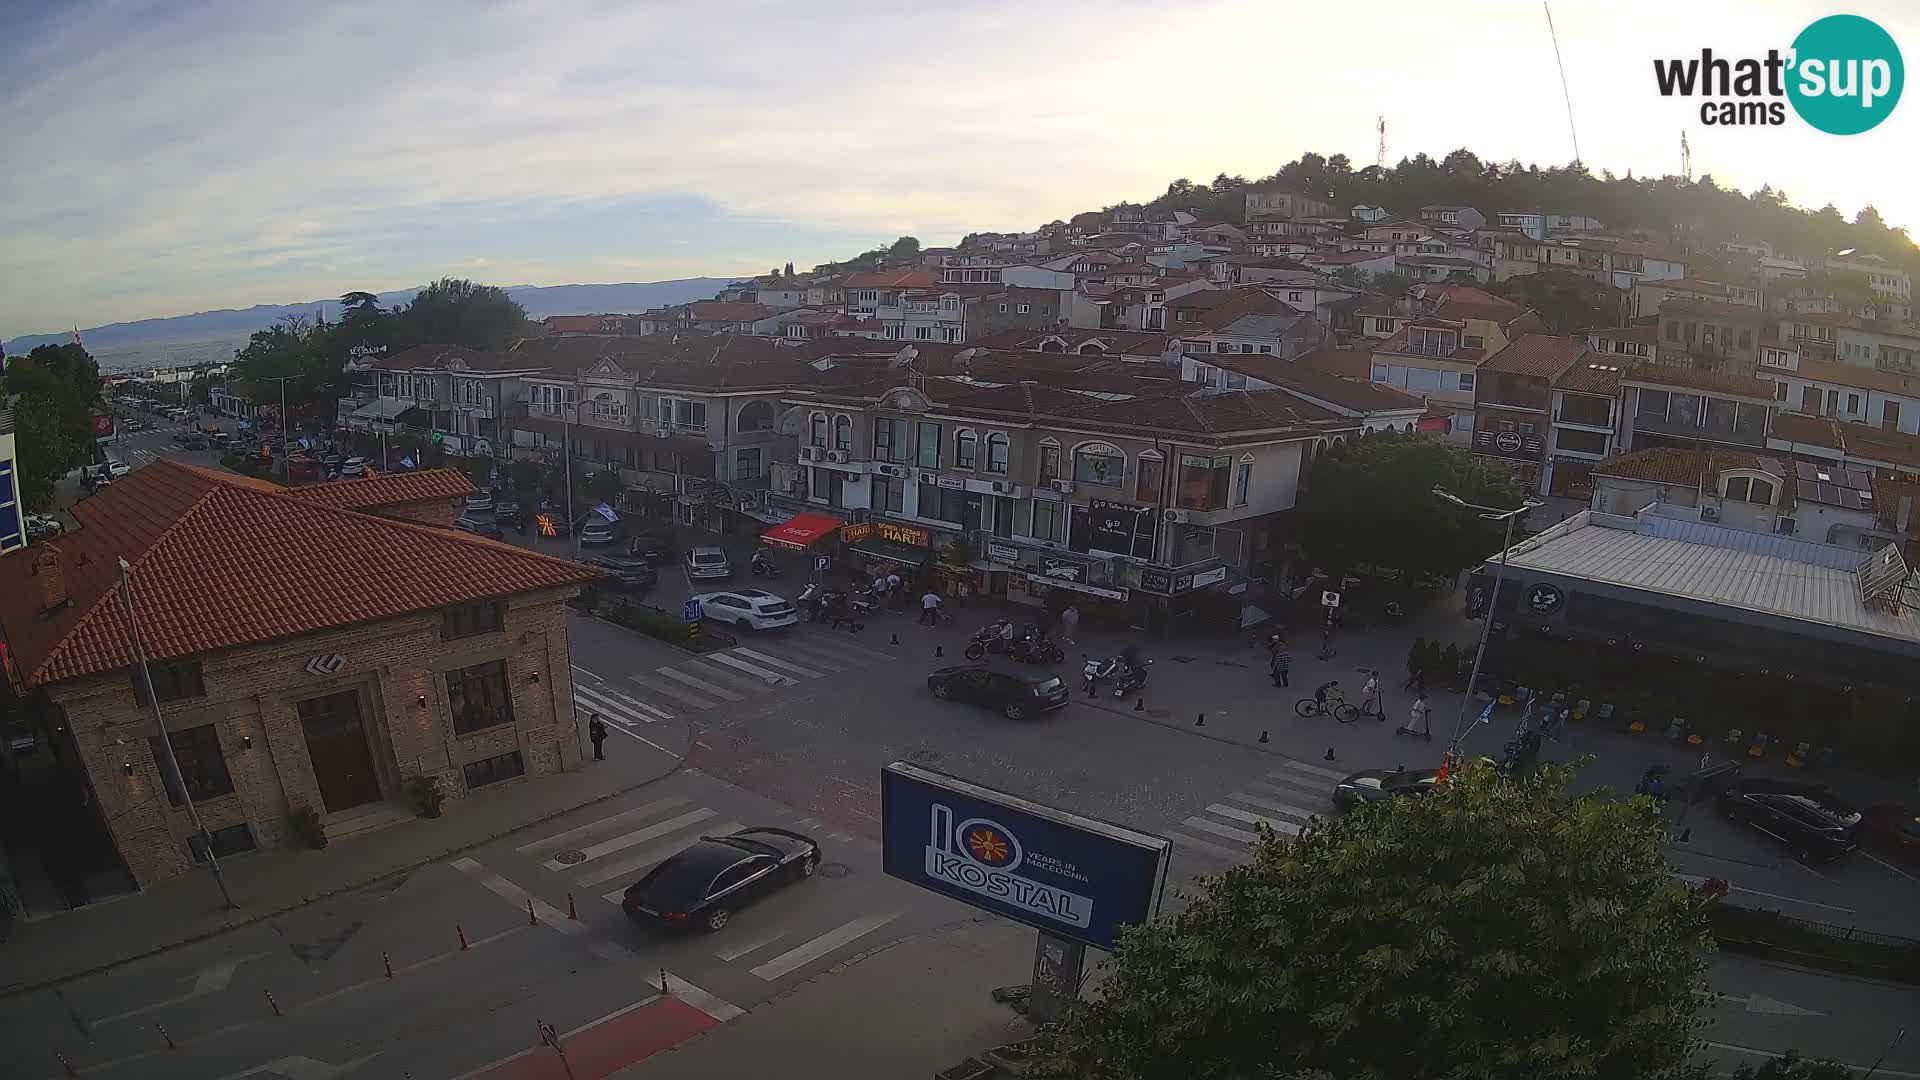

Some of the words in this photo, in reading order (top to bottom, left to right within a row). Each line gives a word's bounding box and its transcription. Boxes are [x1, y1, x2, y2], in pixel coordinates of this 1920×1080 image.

[883, 529, 916, 545] HARI
[818, 558, 826, 569] P
[930, 803, 1023, 871] 10
[1026, 858, 1089, 884] MACEDONIA
[1027, 851, 1063, 867] YEARS
[1065, 862, 1076, 872] IN
[934, 852, 1080, 921] KOSTAL
